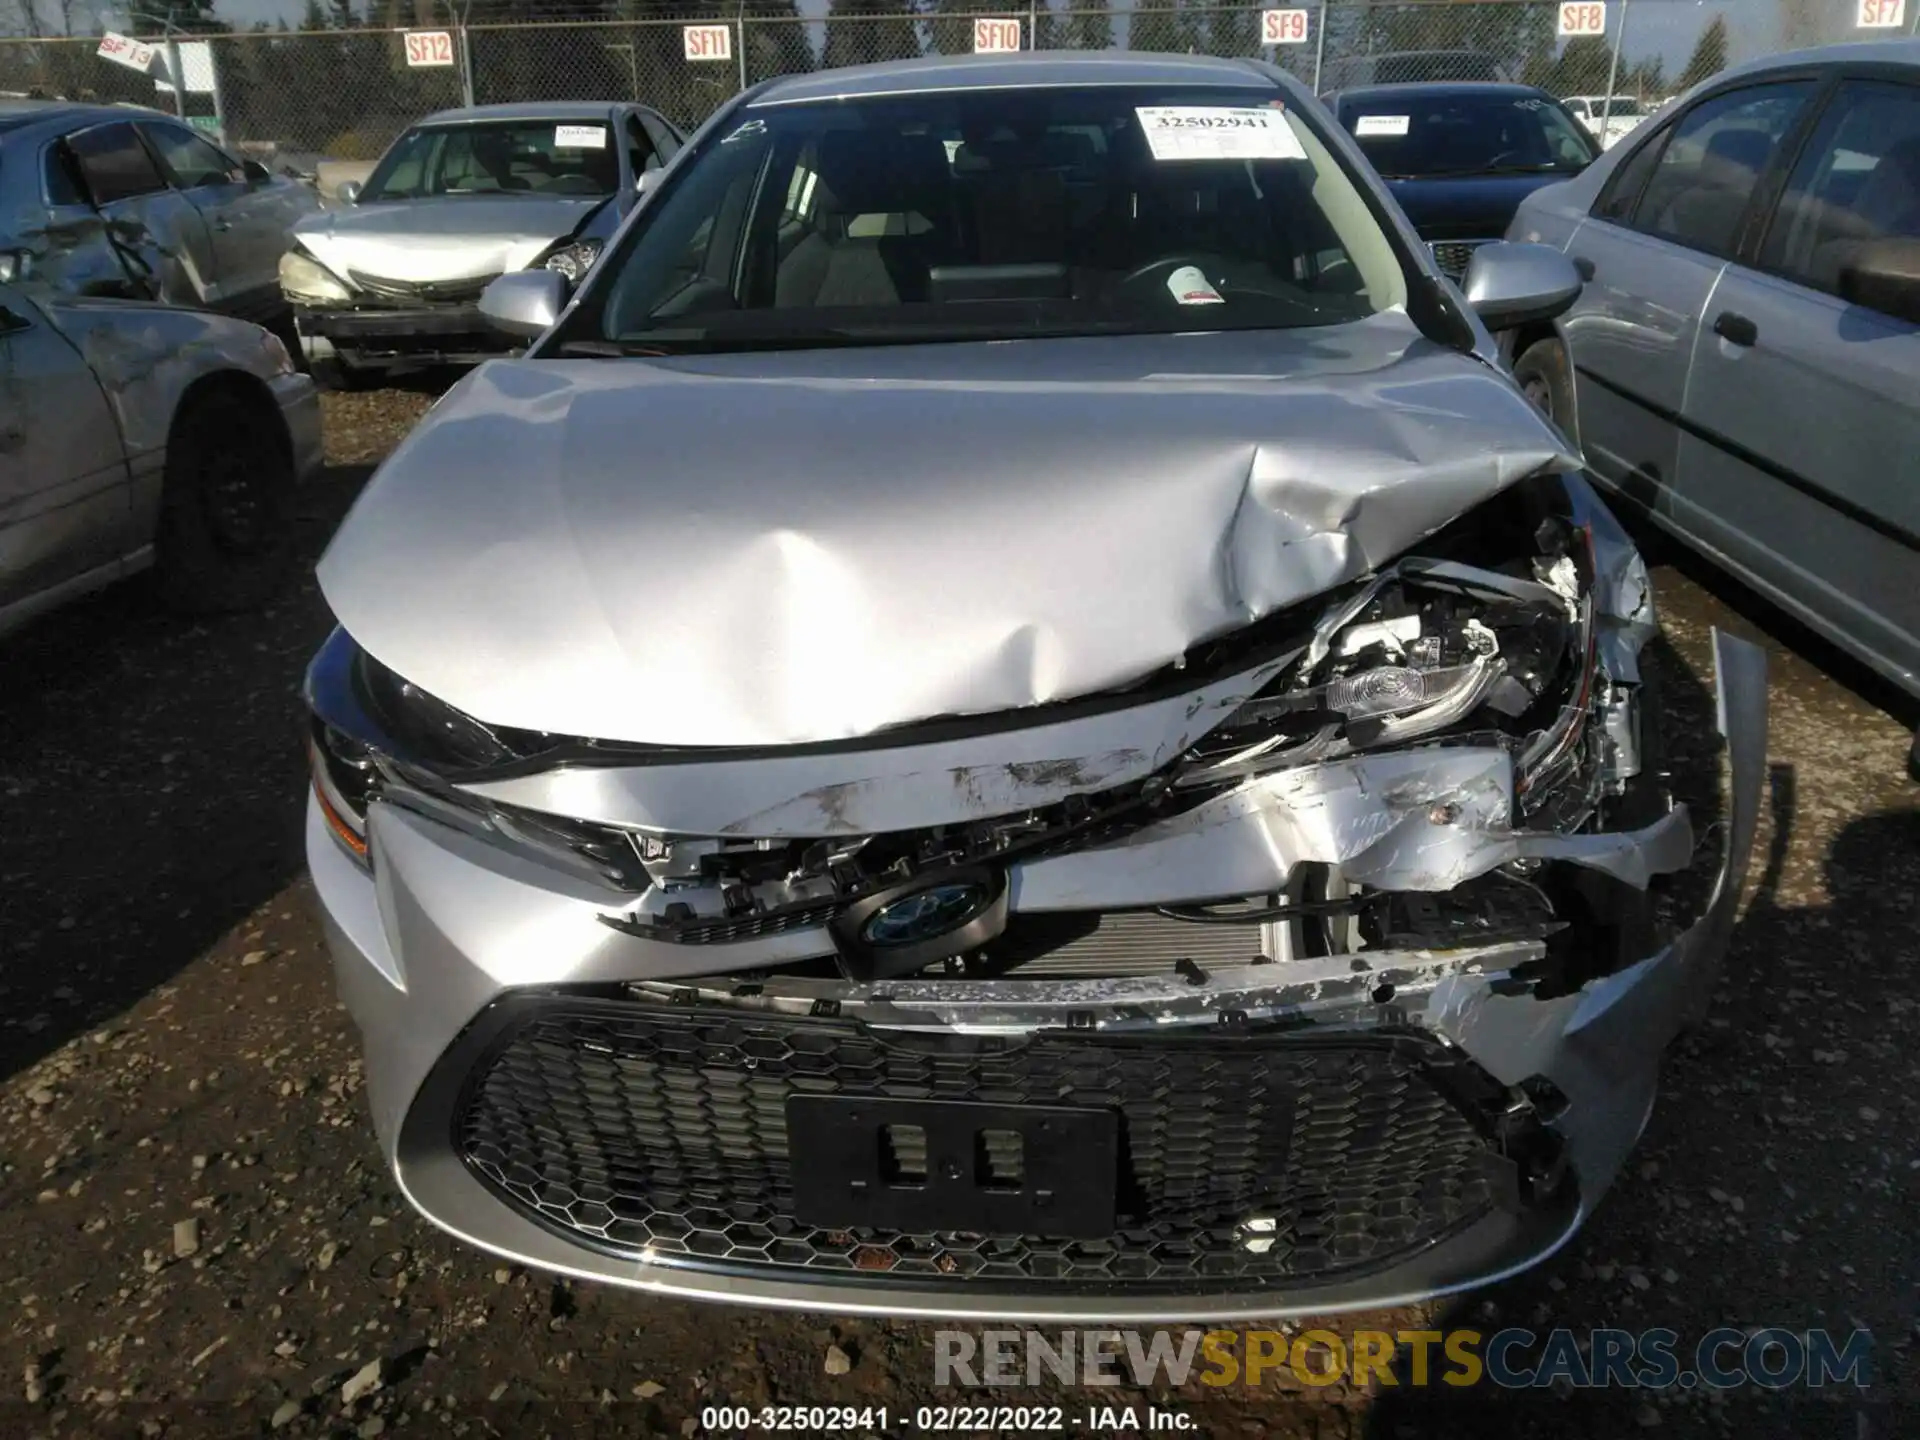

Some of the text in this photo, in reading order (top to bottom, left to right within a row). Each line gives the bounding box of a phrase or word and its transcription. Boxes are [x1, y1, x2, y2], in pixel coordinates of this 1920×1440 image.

[1562, 4, 1604, 32] SF8
[1863, 0, 1900, 24] SF7
[976, 21, 1019, 50] SF10
[1266, 12, 1306, 41] SF9
[408, 34, 452, 62] SF12
[688, 28, 728, 57] SF11
[1157, 116, 1269, 129] 32502941
